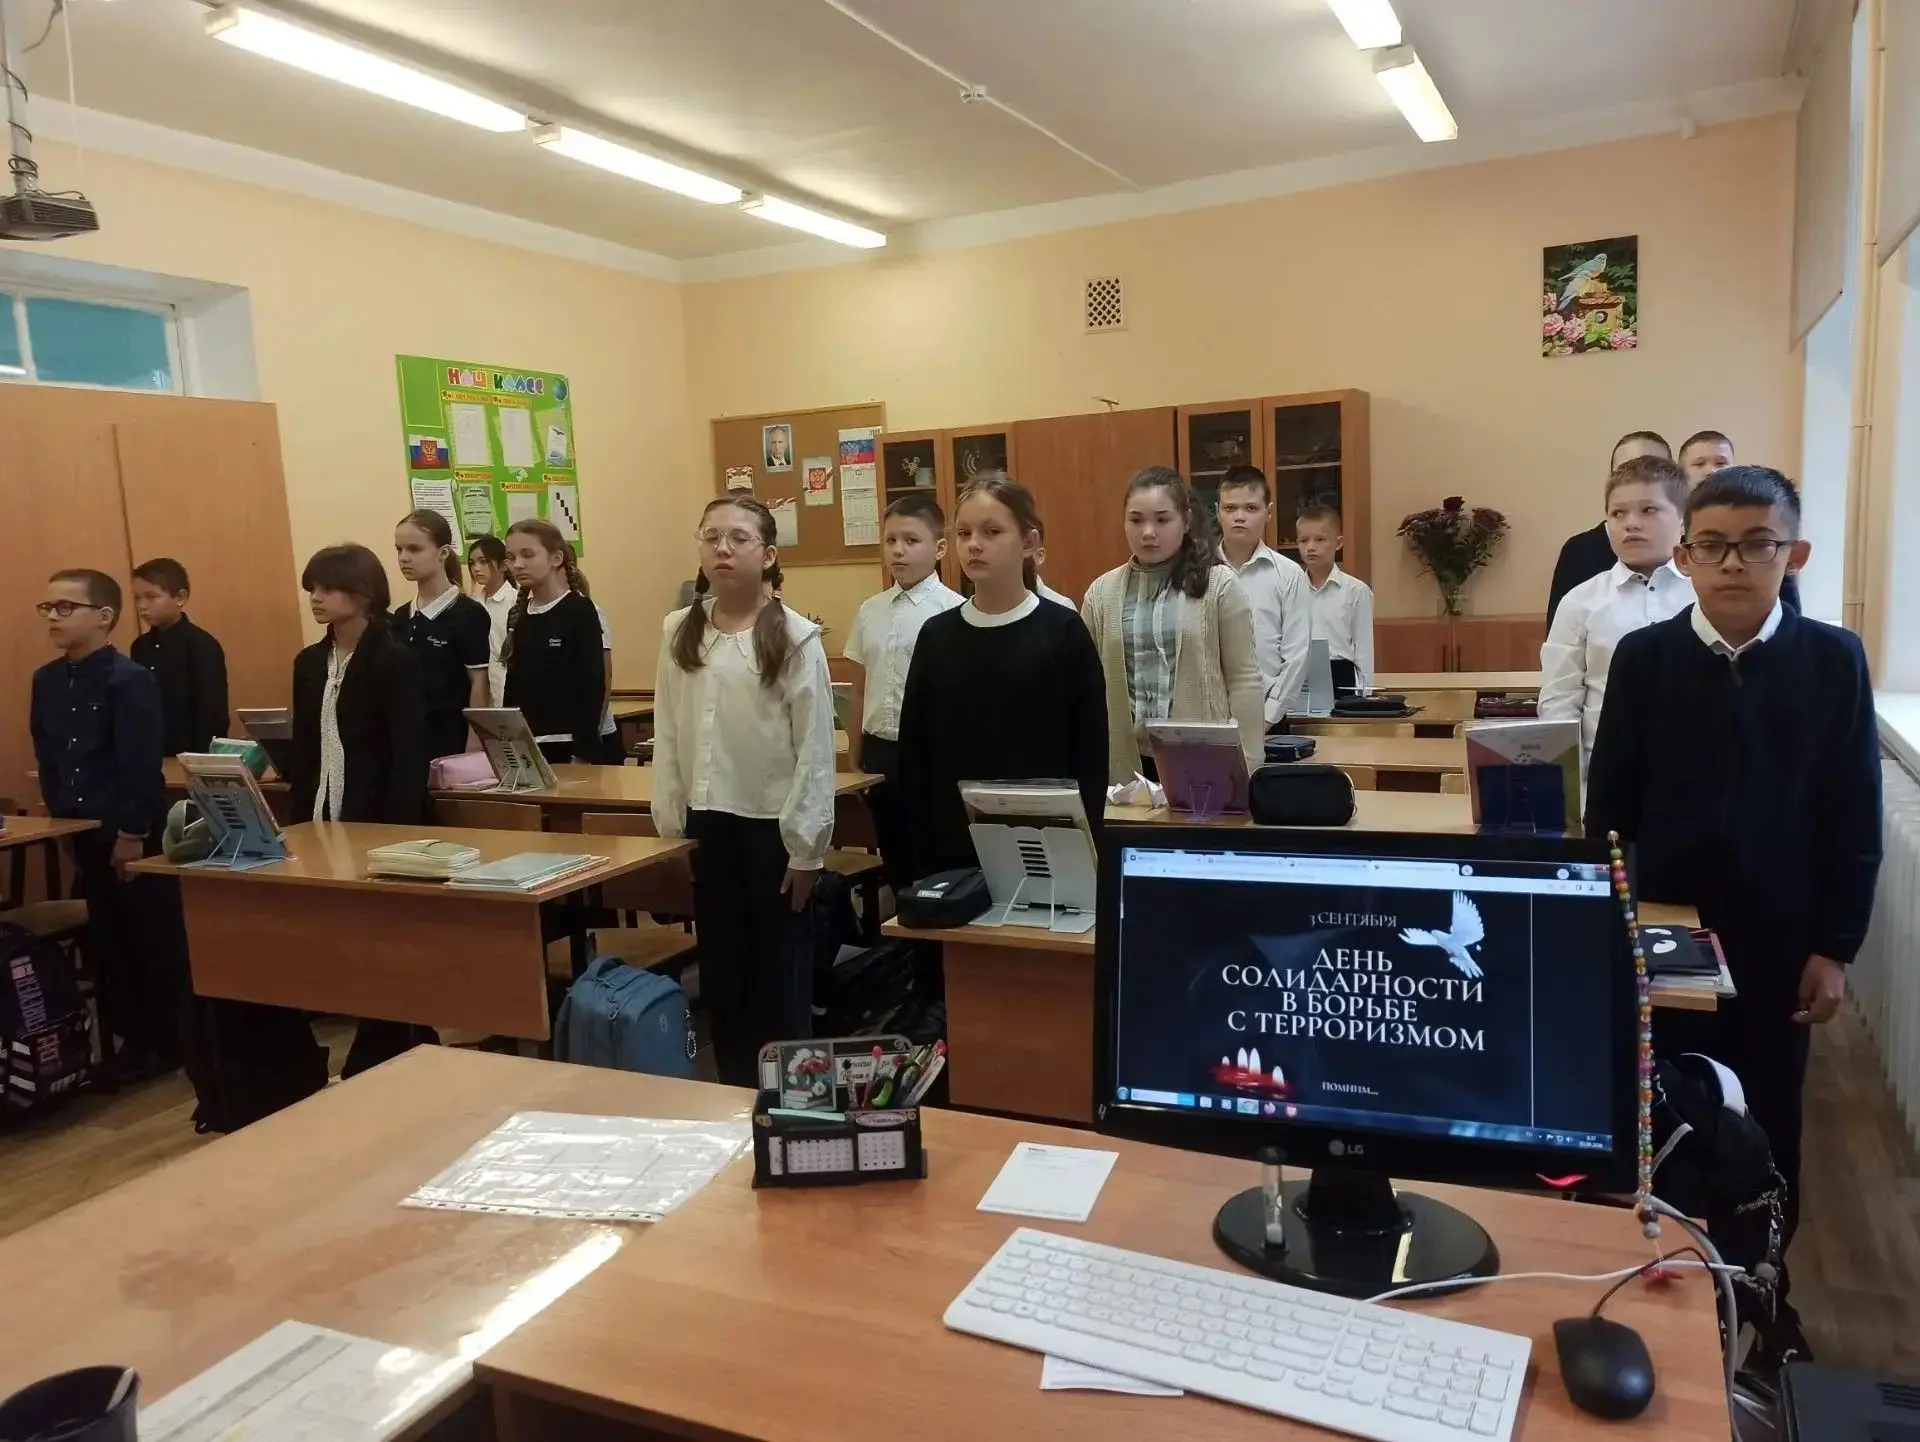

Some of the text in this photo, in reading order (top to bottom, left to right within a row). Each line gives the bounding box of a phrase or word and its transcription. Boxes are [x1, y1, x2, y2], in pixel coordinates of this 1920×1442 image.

[448, 367, 545, 395] НАШ КЛАСС
[1317, 912, 1397, 928] СЕНТЯБРЯ
[1312, 948, 1393, 973] ДЕНЬ
[1221, 964, 1484, 1003] СОЛИДАРНОСТИ
[1282, 991, 1419, 1023] В БОРЬБЕ
[1227, 1010, 1486, 1051] С ТЕРРОРИЗМОМ
[1347, 1144, 1364, 1155] LG
